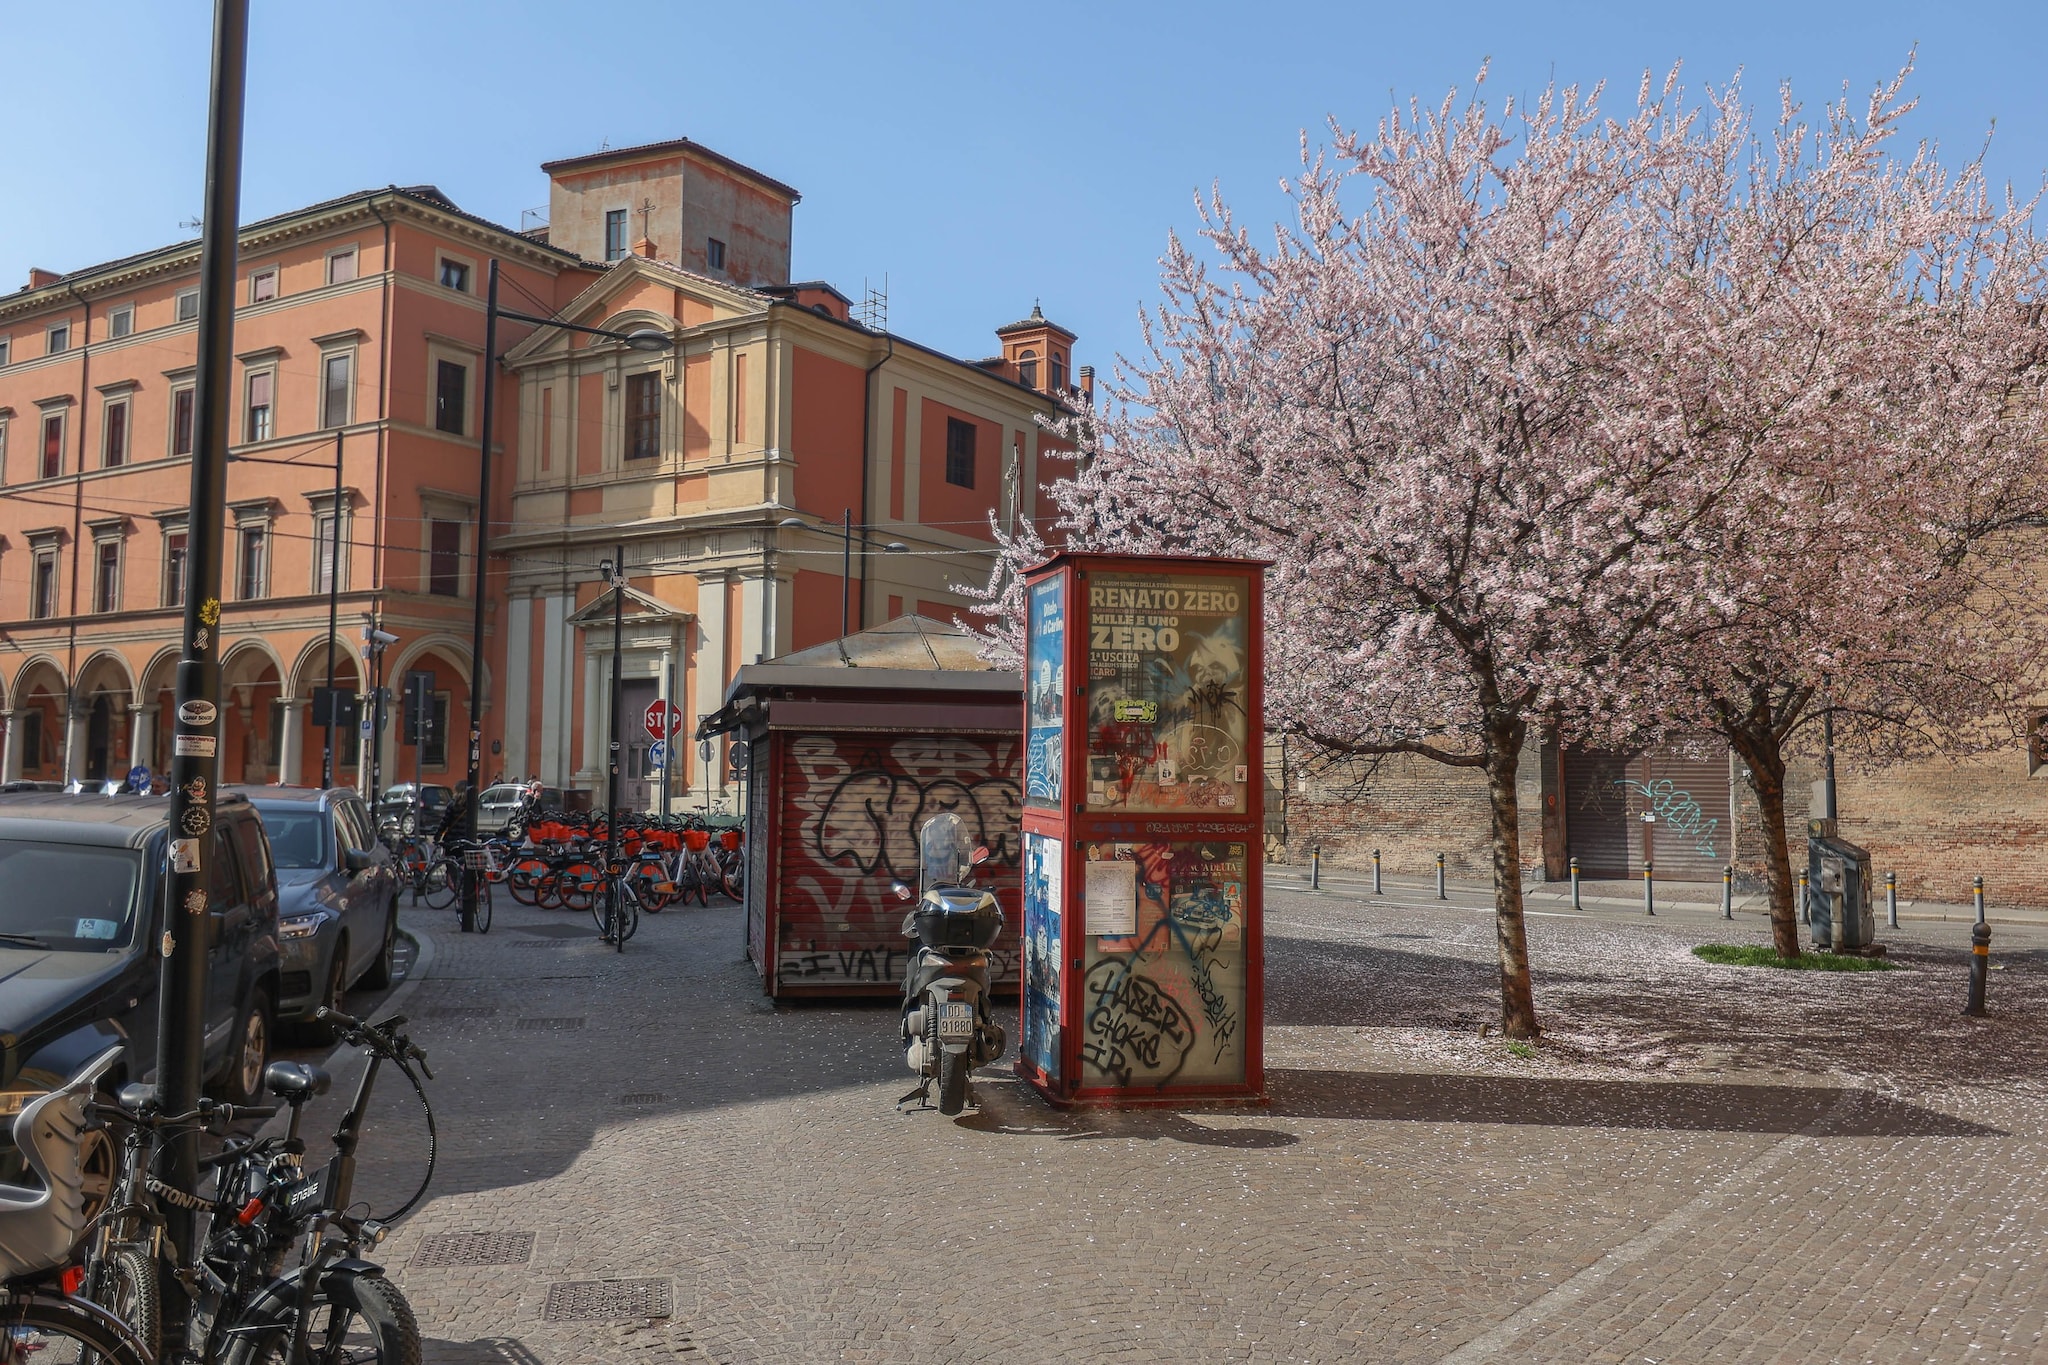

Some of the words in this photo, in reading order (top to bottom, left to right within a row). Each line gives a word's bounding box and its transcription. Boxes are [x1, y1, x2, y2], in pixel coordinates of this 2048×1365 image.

[1090, 587, 1180, 610] RENATO
[1183, 590, 1240, 613] ZERO
[1092, 614, 1134, 625] MILLE
[1136, 616, 1145, 625] E
[1147, 616, 1179, 627] UNO
[1090, 626, 1180, 652] ZERO
[1102, 652, 1140, 663] USCITA
[1090, 667, 1116, 677] ICARO
[146, 1178, 216, 1212] YPTONITE
